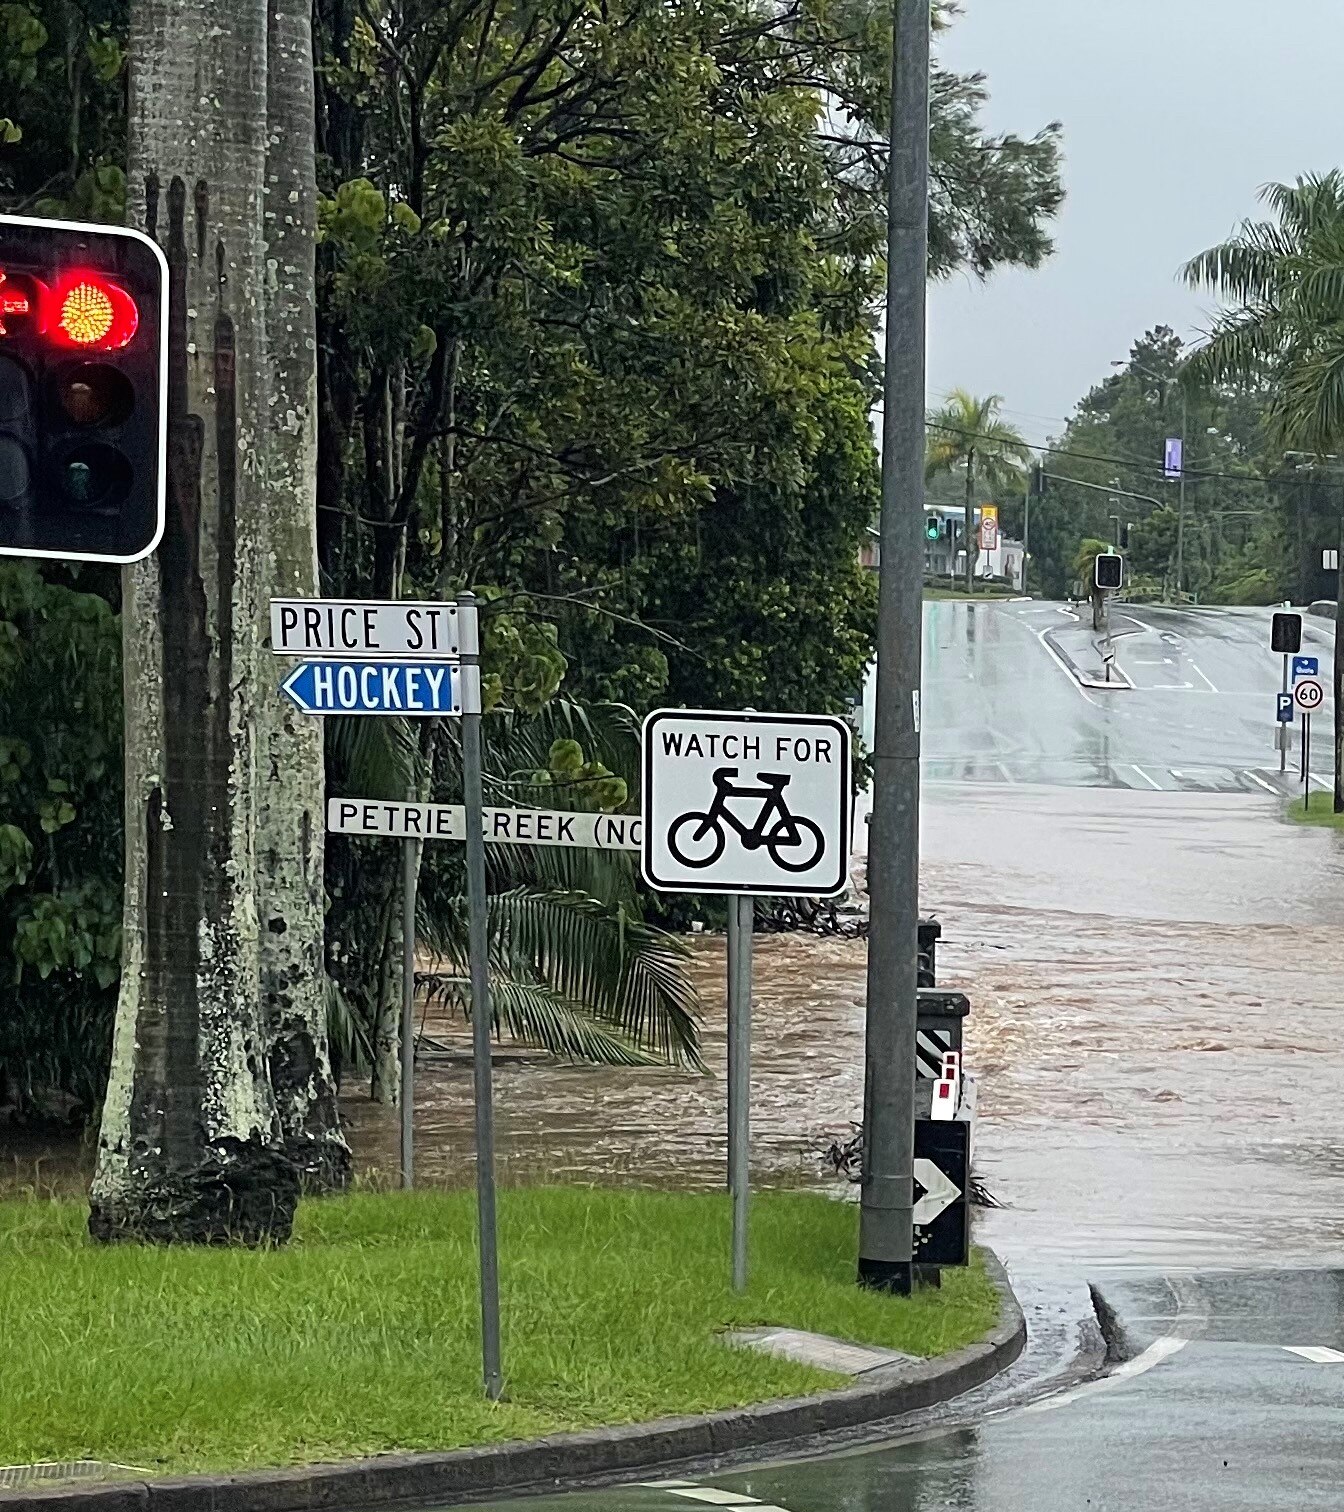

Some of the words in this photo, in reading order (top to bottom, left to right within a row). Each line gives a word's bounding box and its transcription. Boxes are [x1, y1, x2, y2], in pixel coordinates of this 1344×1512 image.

[280, 607, 380, 649] PRICE
[406, 609, 441, 650] ST
[314, 665, 446, 709] HOCKEY
[1299, 688, 1318, 701] 60
[661, 732, 760, 760] WATCH
[776, 737, 832, 764] FOR
[339, 803, 453, 835] PETRIE
